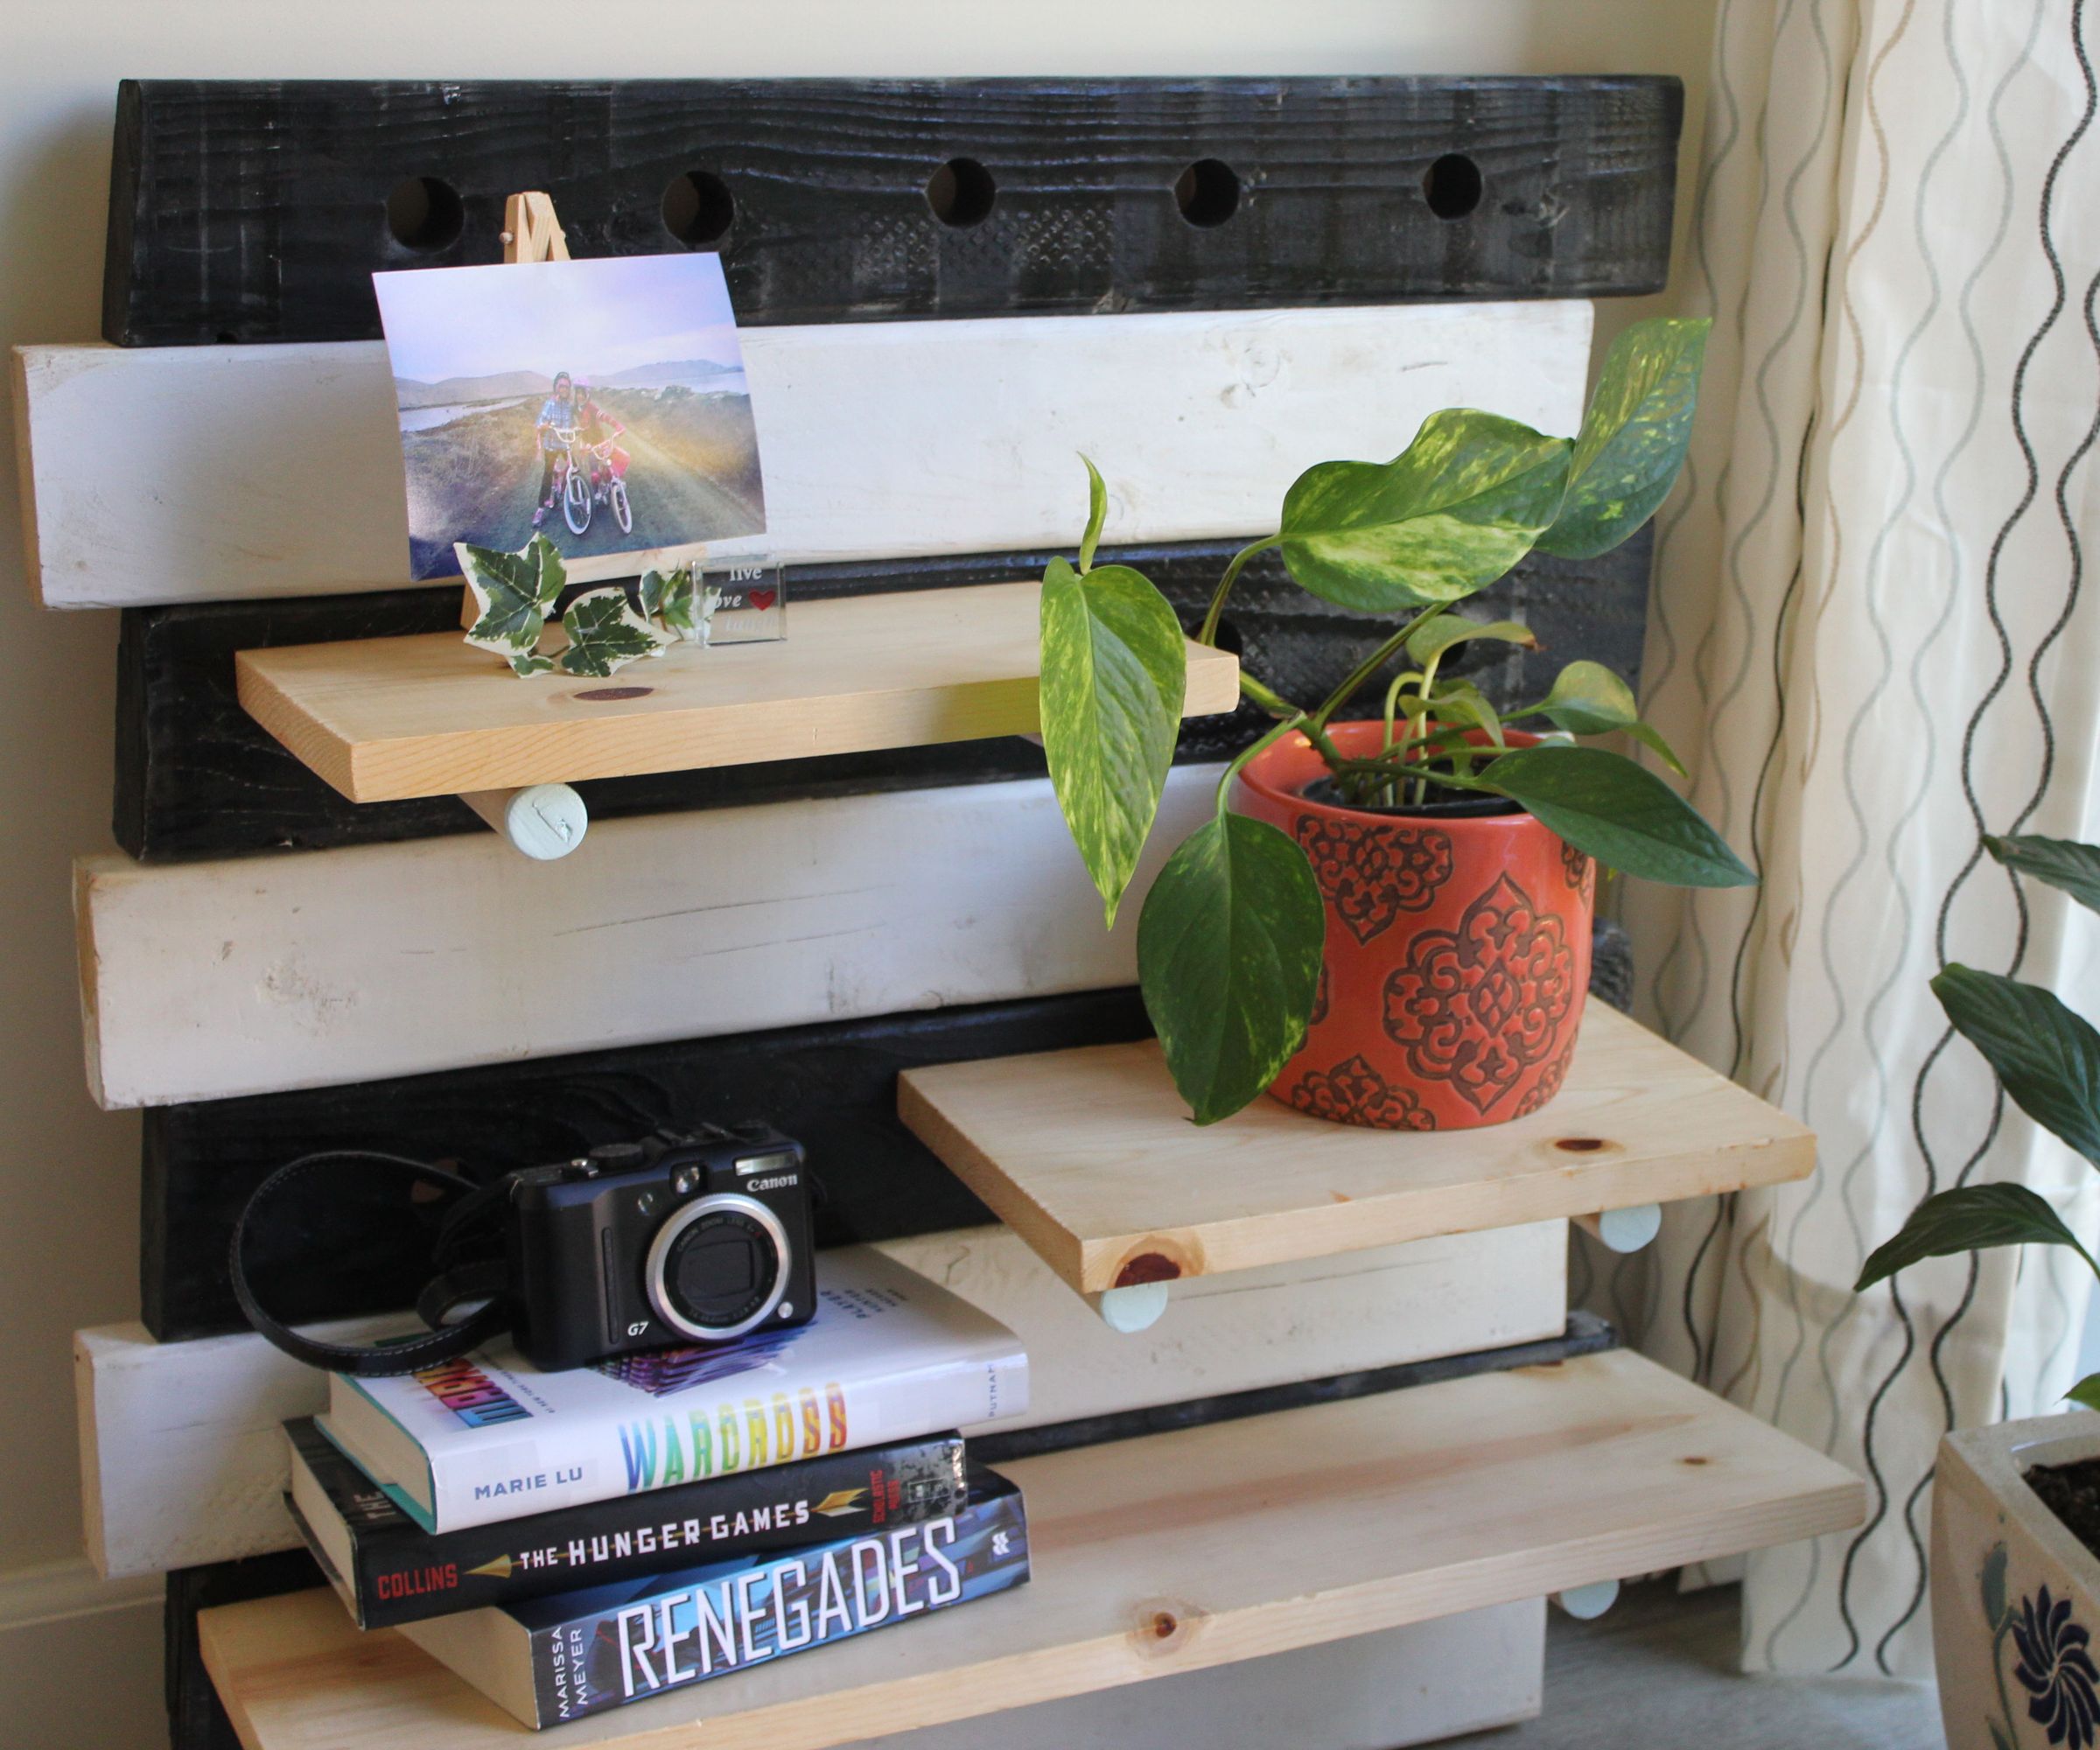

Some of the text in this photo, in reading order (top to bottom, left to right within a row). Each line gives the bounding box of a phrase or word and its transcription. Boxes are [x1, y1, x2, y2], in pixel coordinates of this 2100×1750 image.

[713, 595, 743, 609] ove
[730, 566, 763, 582] live
[746, 1174, 798, 1193] Canon
[627, 1320, 649, 1337] G7
[474, 1362, 998, 1501] MARIE LU WARCROSS PUTNAM
[377, 1500, 810, 1600] COLLINS THE HUNGER GAMES
[617, 1516, 961, 1698] RENEGADES
[551, 1627, 570, 1718] MARISSA
[570, 1628, 589, 1705] MEYER
